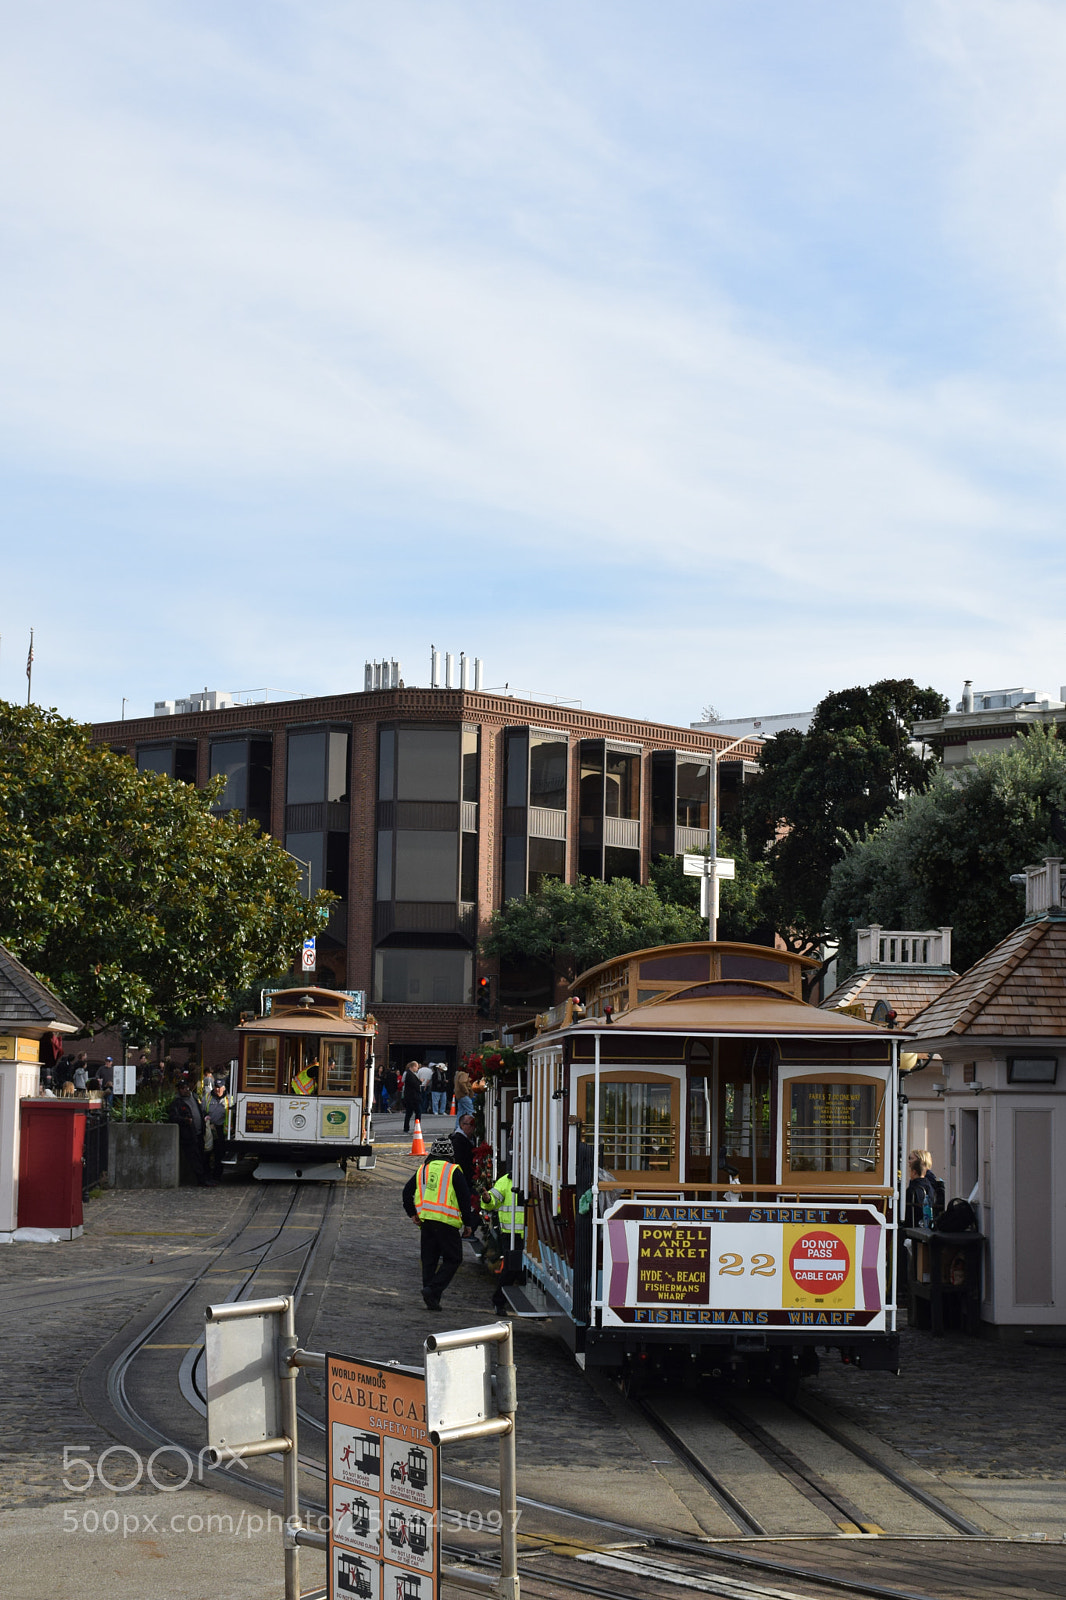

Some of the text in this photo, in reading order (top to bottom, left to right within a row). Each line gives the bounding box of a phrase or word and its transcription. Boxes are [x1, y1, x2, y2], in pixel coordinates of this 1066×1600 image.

[289, 1101, 310, 1110] 27
[643, 1207, 728, 1221] MARKET
[749, 1208, 830, 1223] STREET
[642, 1230, 706, 1240] POWELL
[802, 1240, 838, 1249] DO NOT
[641, 1248, 708, 1258] MARKET
[808, 1249, 832, 1258] PASS
[719, 1253, 776, 1277] 22
[640, 1270, 662, 1282] HYDE
[677, 1271, 706, 1283] BEACH
[795, 1272, 844, 1281] CABLE CAR
[645, 1284, 700, 1292] FISHERMANS
[634, 1310, 856, 1325] FISHERMANS WHARF
[331, 1366, 386, 1389] WORLD FAMOUS
[332, 1382, 388, 1414] CABLE
[369, 1416, 430, 1442] SAFETY TIP
